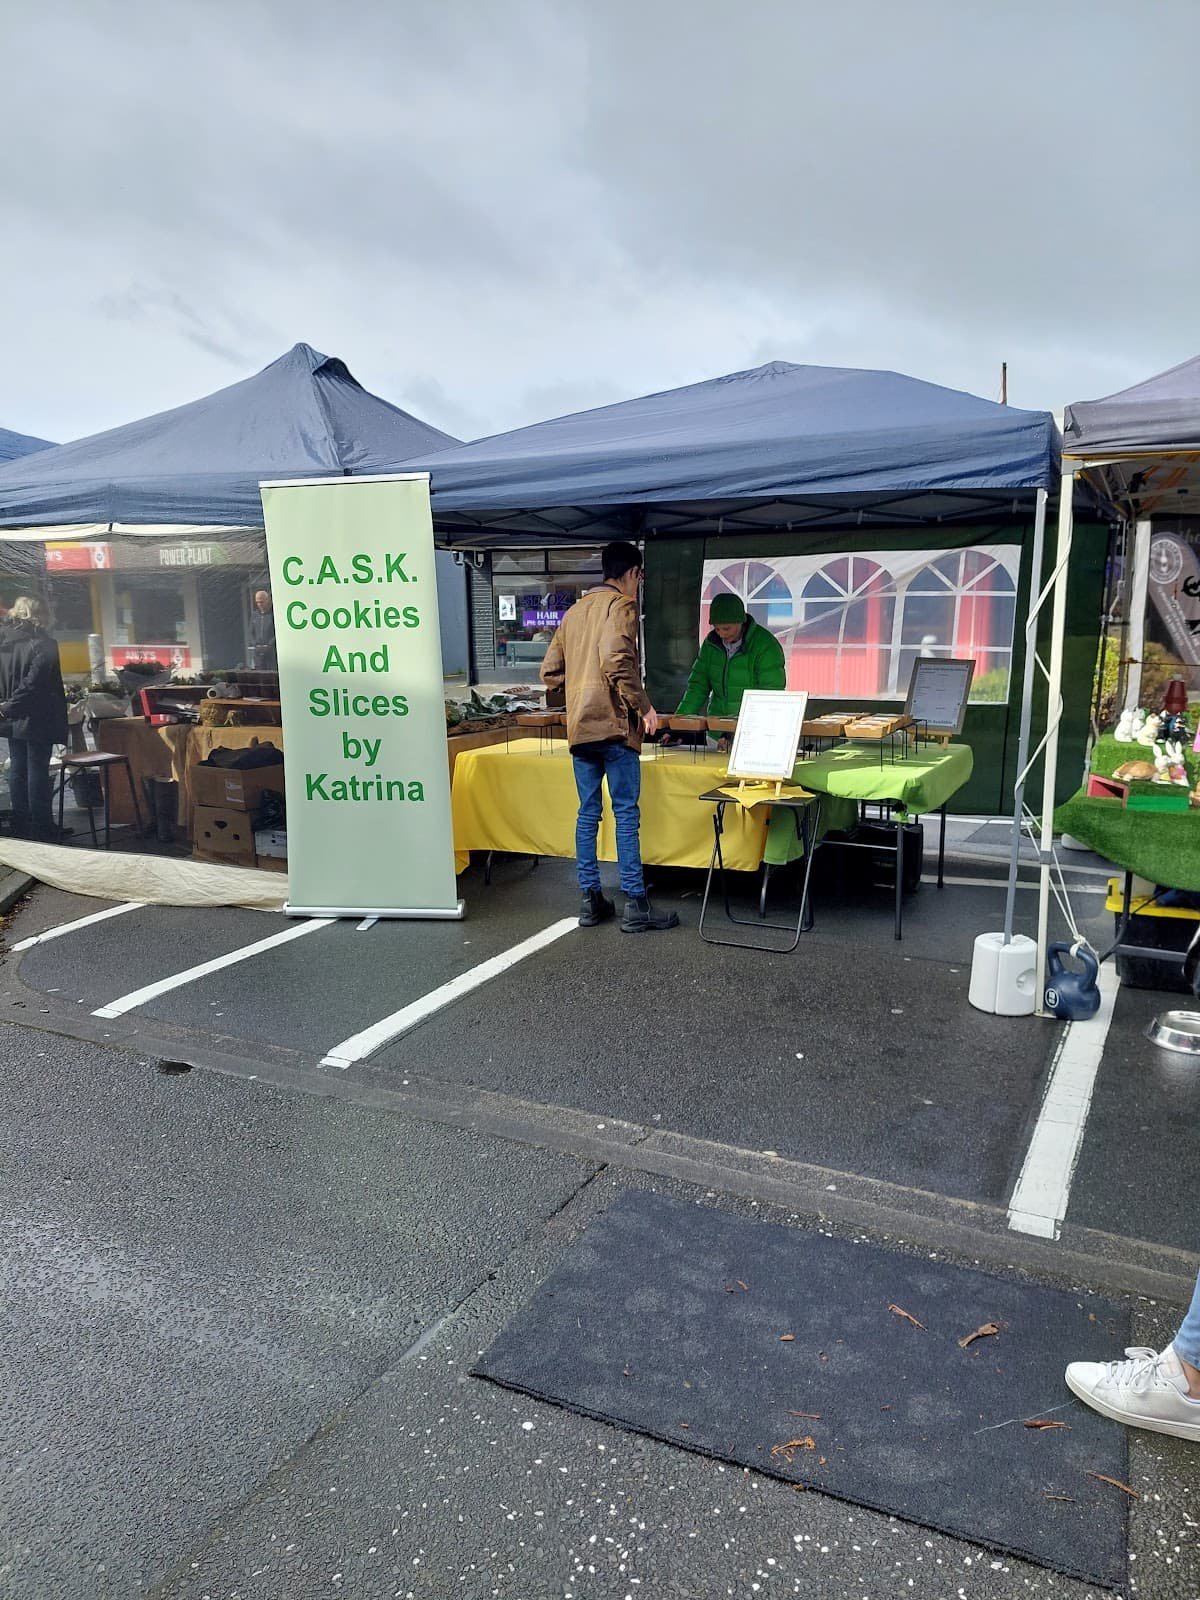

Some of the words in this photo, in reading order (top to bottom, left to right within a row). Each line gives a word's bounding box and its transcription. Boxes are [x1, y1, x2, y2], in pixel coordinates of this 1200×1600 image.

[159, 549, 186, 567] POWER
[187, 547, 212, 566] PLANT
[282, 552, 418, 585] C.A.S.K.
[286, 600, 420, 630] Cookies
[536, 611, 559, 620] HAIR
[322, 644, 389, 673] And
[309, 688, 409, 717] Slices
[342, 731, 382, 766] by
[305, 773, 425, 802] Katrina
